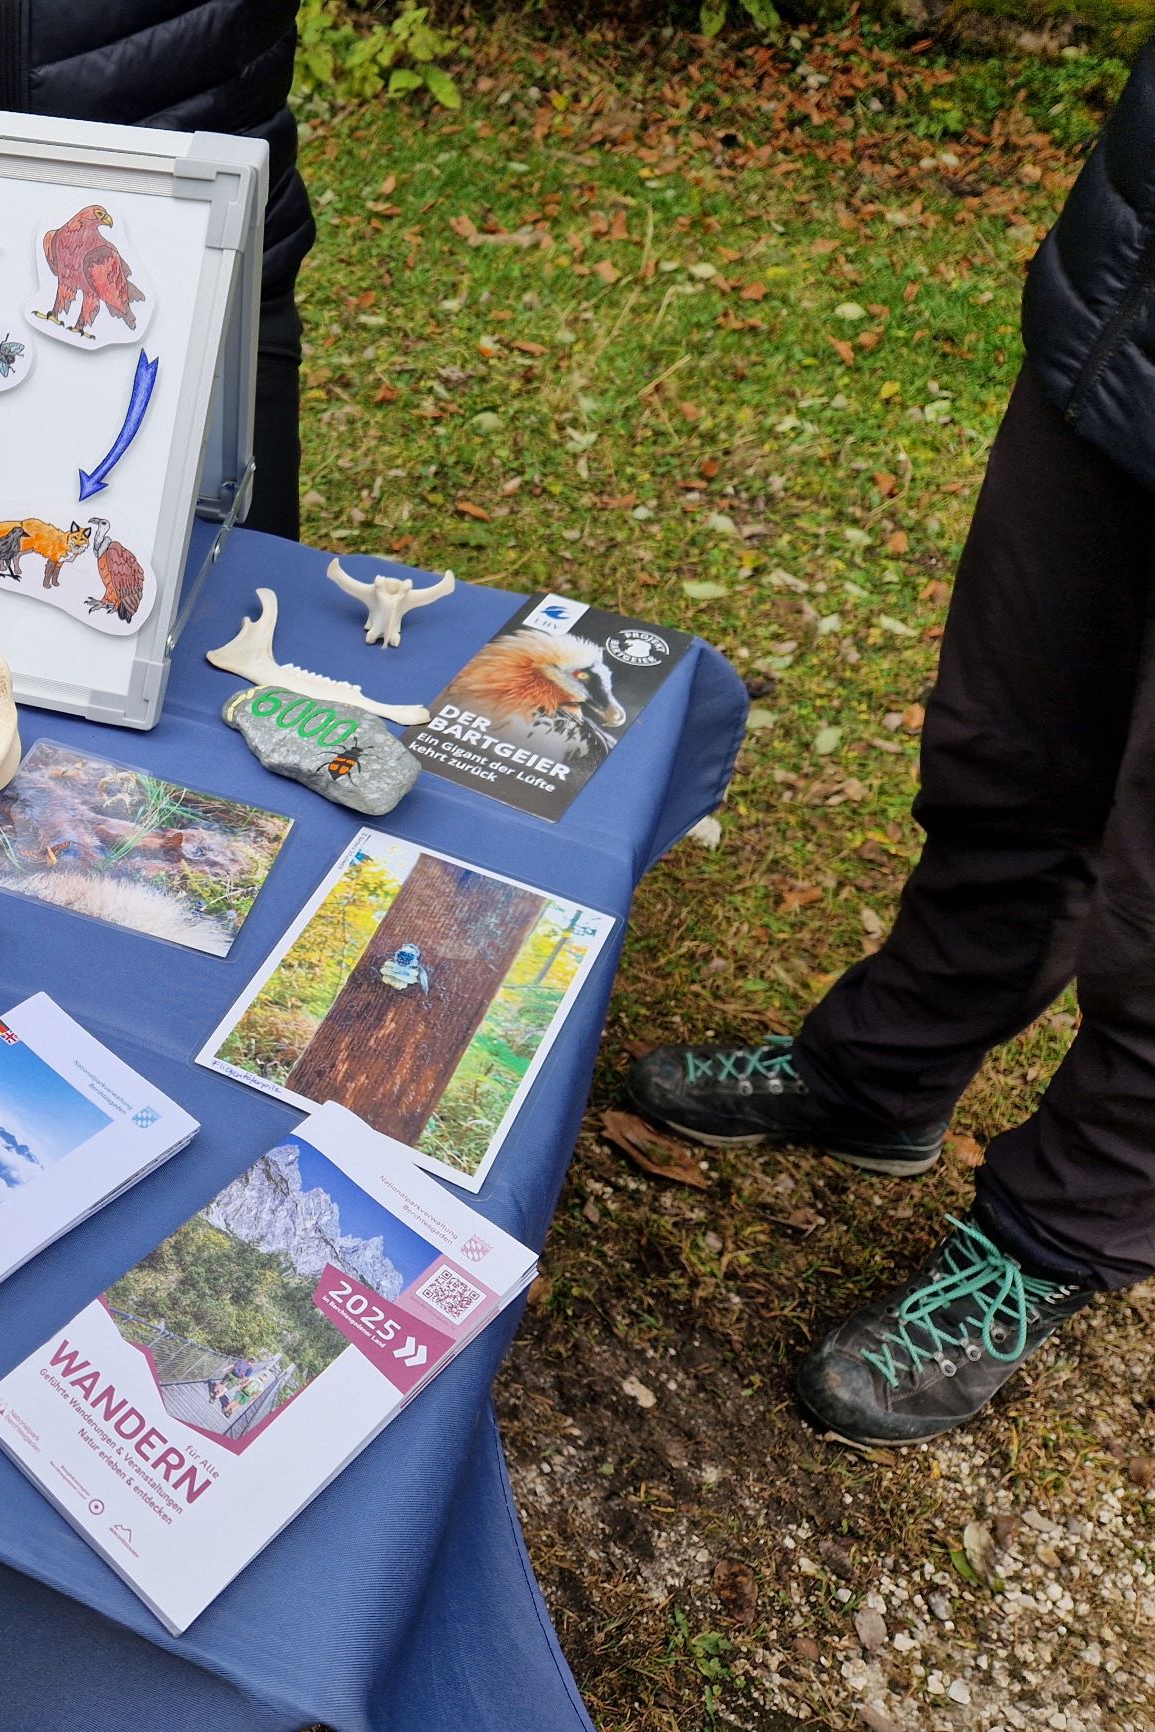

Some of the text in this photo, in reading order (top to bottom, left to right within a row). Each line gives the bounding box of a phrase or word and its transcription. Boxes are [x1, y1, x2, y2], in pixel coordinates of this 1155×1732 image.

[610, 638, 658, 664] BARTGEIER
[624, 632, 666, 653] PROJEKT
[251, 688, 359, 747] 6000
[438, 704, 492, 732] DER
[408, 741, 499, 783] kehrt zurück
[415, 732, 557, 793] Ein Gigant der Lüfte
[427, 717, 572, 781] BARTGEIER
[379, 1175, 459, 1240] Nationalparkverwaltung
[402, 1204, 453, 1246] Berchtesgaden
[329, 1280, 402, 1341] 2025
[329, 1301, 372, 1337] Berchtesgadener
[371, 1335, 387, 1348] Land
[39, 1368, 70, 1400] Geführte
[69, 1397, 117, 1449] Wanderungen
[116, 1446, 125, 1456] &
[124, 1452, 184, 1514] Veranstaltungen
[49, 1339, 212, 1504] WANDERN
[77, 1427, 173, 1525] Natur erleben & entdecken
[185, 1445, 220, 1480] für Alle
